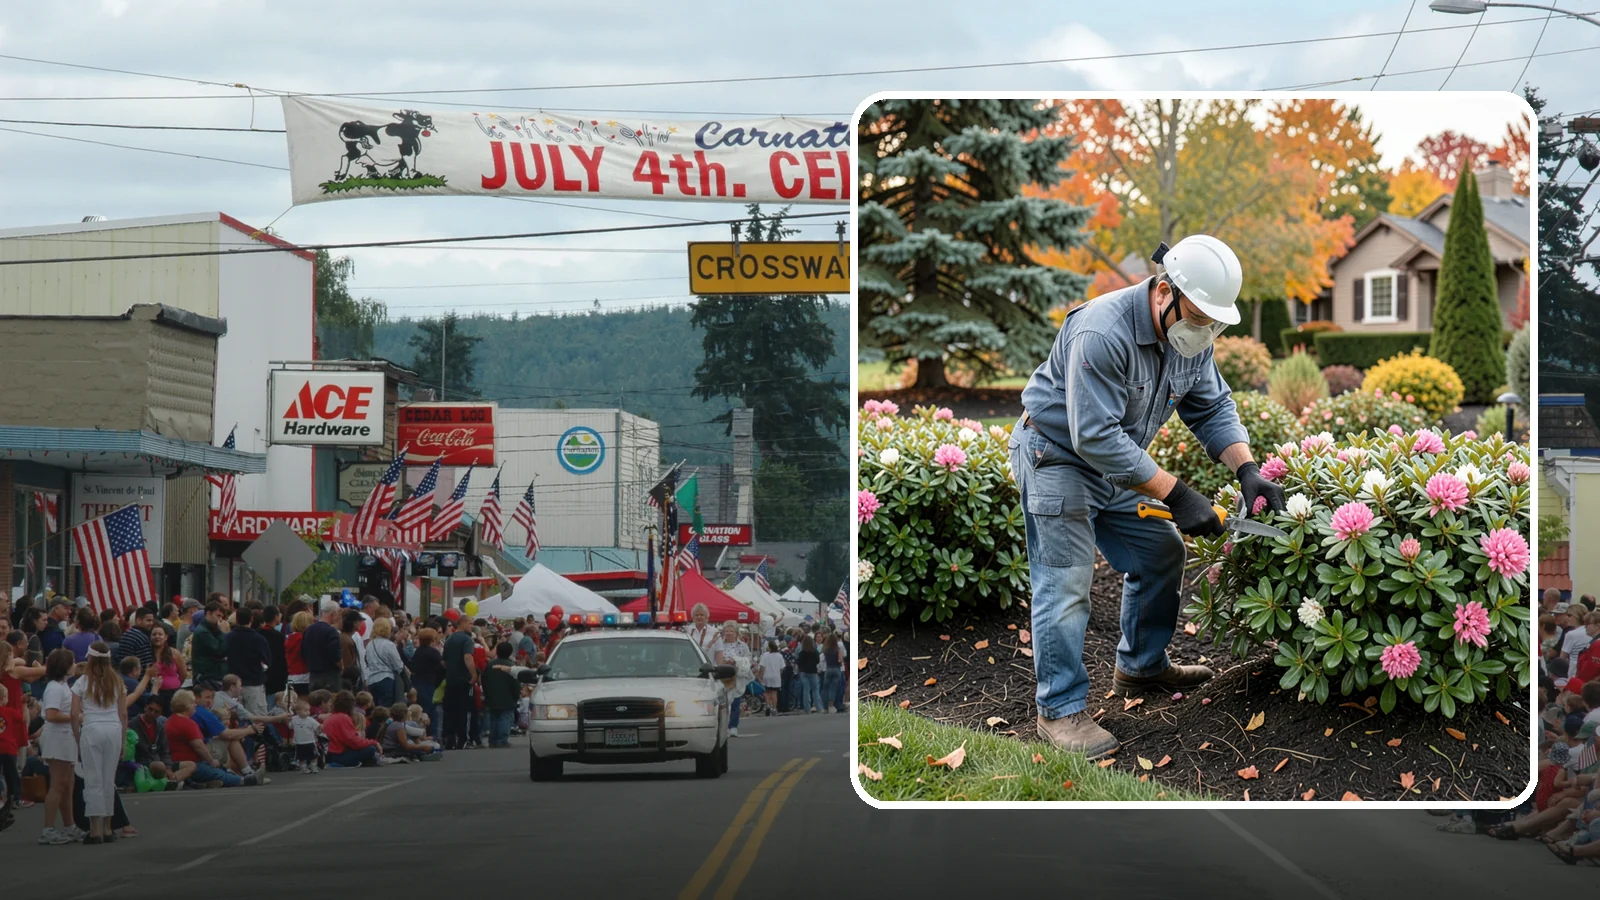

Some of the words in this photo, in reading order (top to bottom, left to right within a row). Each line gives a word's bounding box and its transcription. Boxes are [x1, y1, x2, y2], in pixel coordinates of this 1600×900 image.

[481, 141, 605, 193] JULY
[632, 150, 746, 198] 4th.
[697, 254, 850, 280] CROSSWA
[283, 380, 373, 420] ACE
[406, 410, 452, 421] CEDAR
[284, 421, 370, 436] Hardware
[96, 486, 124, 495] Vincent
[126, 487, 136, 495] de
[138, 486, 155, 495] Paul
[688, 526, 741, 535] CRNATION
[699, 535, 730, 543] GLASS
